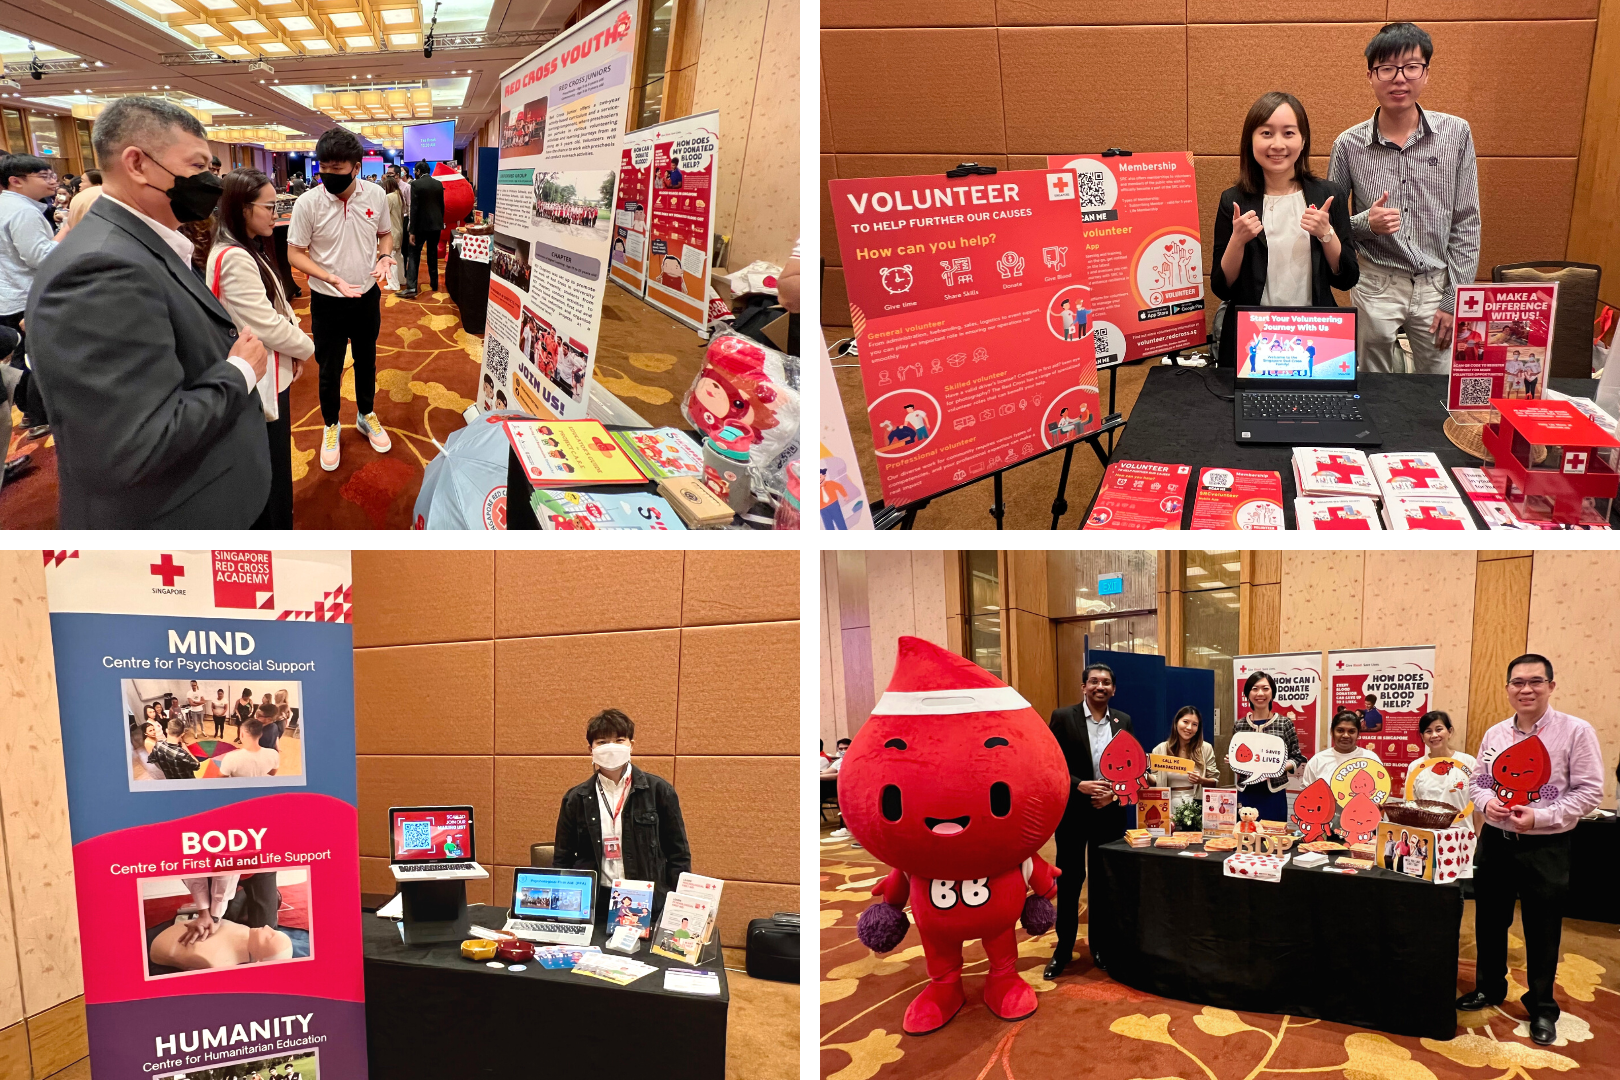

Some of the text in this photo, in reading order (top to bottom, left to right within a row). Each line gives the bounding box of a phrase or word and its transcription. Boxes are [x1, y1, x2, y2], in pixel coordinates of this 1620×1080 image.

[505, 79, 521, 97] RED
[523, 57, 558, 88] CROSS
[561, 23, 619, 68] YOUTH
[569, 76, 585, 86] CROSS
[585, 65, 612, 82] JUNIORS
[692, 137, 709, 145] DOES
[683, 144, 714, 154] DONATED
[681, 153, 702, 161] BLOOD
[1119, 161, 1177, 171] Membership
[847, 183, 1020, 214] VOLUNTEER
[851, 208, 1033, 234] TO HELP FURTHER OUR CAUSES
[1083, 226, 1133, 238] volunteer
[856, 233, 997, 261] How can you help?
[551, 252, 572, 263] CHAPTER
[1056, 272, 1072, 281] Blood
[1002, 281, 1023, 291] Donate
[944, 289, 979, 301] Share Skills
[1165, 289, 1196, 299] VOLUNTEER
[1497, 293, 1528, 301] MAKE
[884, 300, 918, 312] Give time
[1291, 315, 1343, 324] Volunteering
[1491, 312, 1539, 320] WITH US!
[867, 319, 946, 340] General volunteer
[1263, 324, 1295, 332] Journey
[886, 331, 929, 345] administration,
[896, 343, 909, 351] play
[918, 335, 946, 345] important
[1137, 330, 1197, 346] volunteer.redcross.sg
[871, 353, 900, 363] smoothly
[944, 371, 1008, 392] Skilled volunteer
[518, 362, 541, 394] JOIN
[542, 386, 566, 416] US!
[955, 389, 991, 404] photography?
[885, 436, 977, 471] Professional volunteer
[900, 467, 921, 476] diverse
[922, 461, 936, 469] work
[1121, 463, 1169, 472] VOLUNTEER
[902, 480, 923, 490] impact
[492, 491, 501, 500] RED
[587, 503, 600, 518] STOP
[215, 550, 269, 563] SINGAPORE
[215, 561, 269, 574] RED CROSS
[216, 572, 270, 584] ACADEMY
[151, 587, 187, 596] SINGAPORE
[1103, 582, 1117, 591] EXIT
[168, 629, 256, 656] MIND
[102, 656, 316, 674] Centre for Psychosocial Support
[1383, 682, 1429, 690] DONATED
[1383, 700, 1411, 708] HELP?
[1254, 754, 1260, 762] 3
[1335, 761, 1368, 781] PROUD
[181, 827, 268, 855] BODY
[1236, 832, 1293, 858] BDP
[110, 849, 331, 876] Centre for First Aid and Life Support
[155, 1012, 315, 1058] HUMANITY
[142, 1033, 327, 1073] Centre for Humanitarian Education
